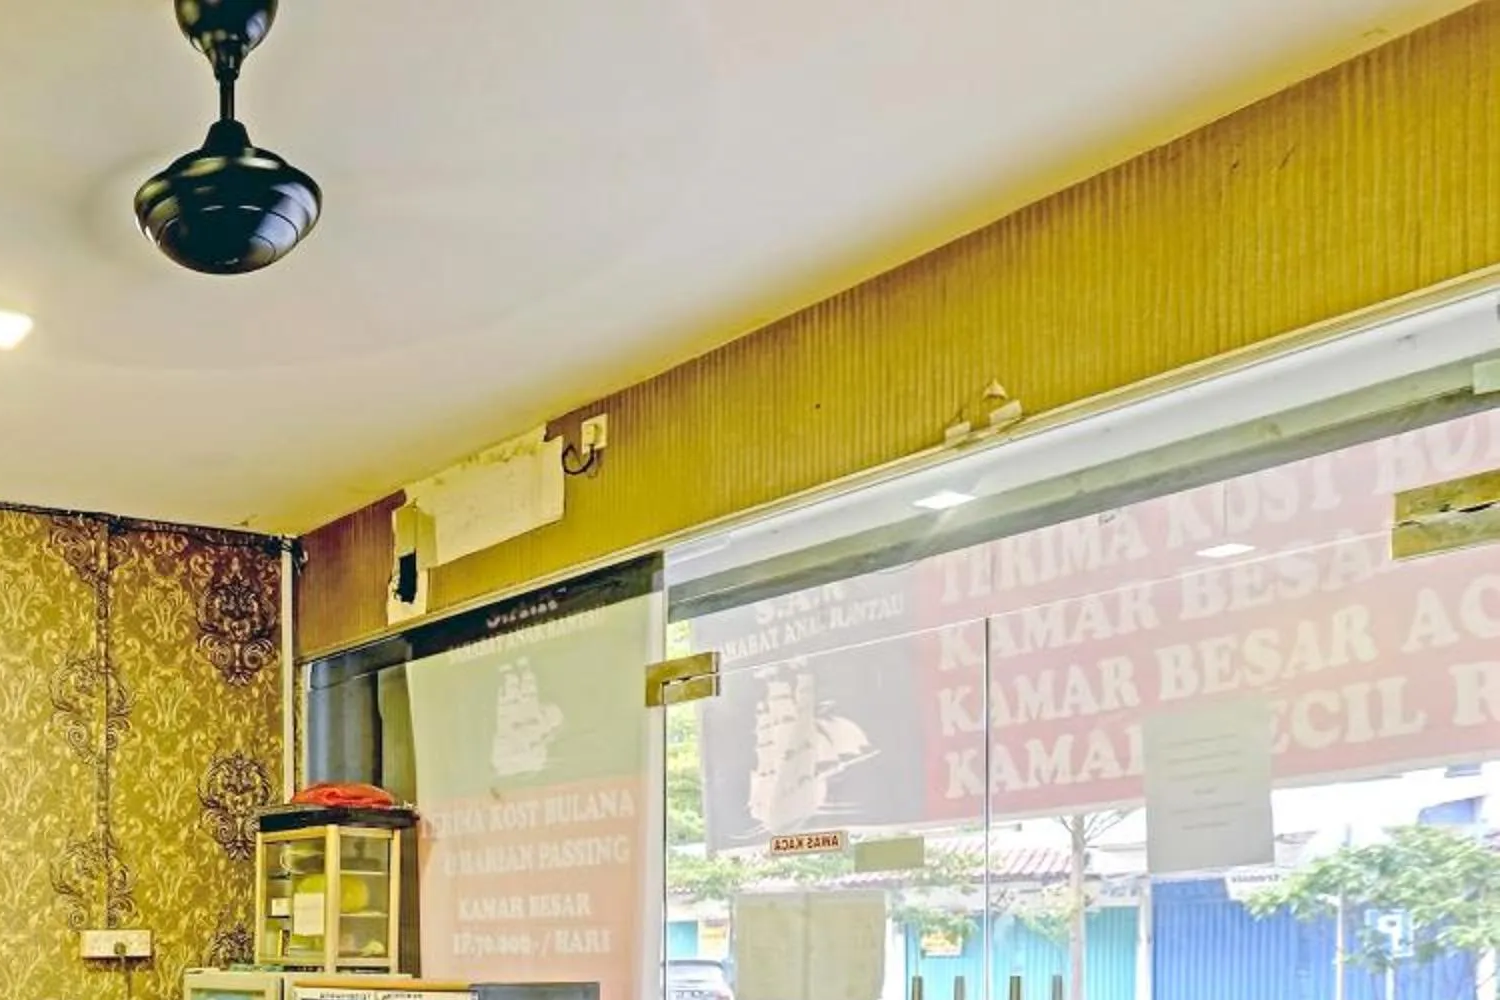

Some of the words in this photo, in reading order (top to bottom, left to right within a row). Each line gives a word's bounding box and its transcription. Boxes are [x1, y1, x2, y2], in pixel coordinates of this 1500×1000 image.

[937, 580, 1160, 674] KAMAR
[1179, 528, 1392, 623] BESA
[938, 518, 1148, 602] TERIMA
[937, 655, 1141, 738] KAMAR
[1158, 603, 1378, 703] BESAR
[942, 720, 1146, 801] KAMA
[1269, 675, 1426, 758] CIL
[537, 834, 631, 871] PASSING
[457, 895, 524, 922] KAMAR
[555, 928, 614, 954] HARI
